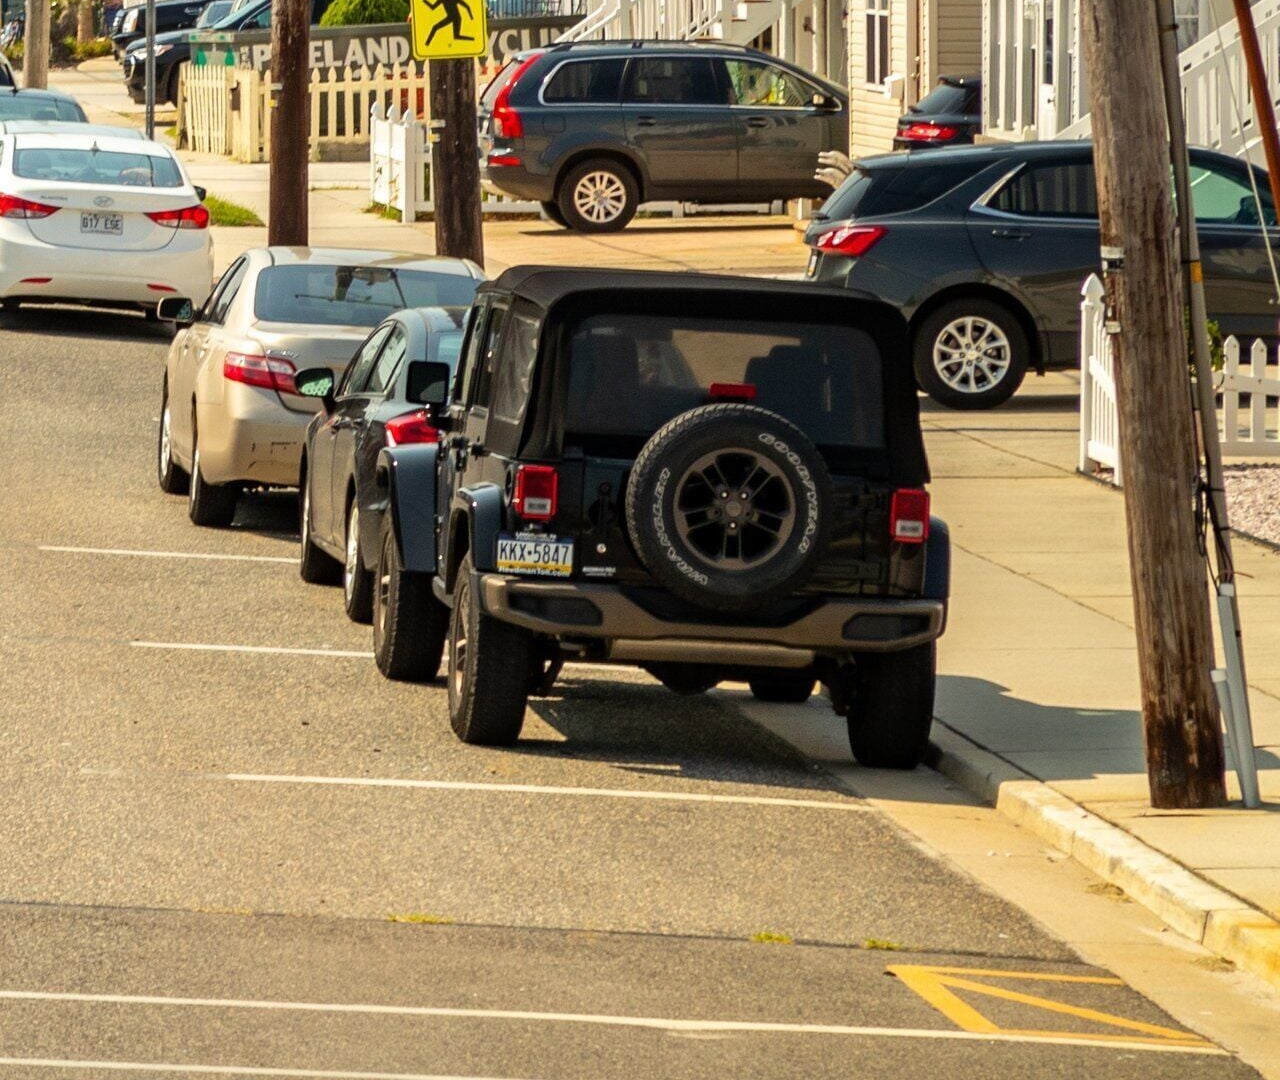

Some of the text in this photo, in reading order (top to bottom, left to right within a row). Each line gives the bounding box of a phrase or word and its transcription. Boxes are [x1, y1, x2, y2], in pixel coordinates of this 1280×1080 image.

[253, 36, 410, 70] PELAND
[653, 467, 709, 586] WRANGLER
[758, 433, 818, 553] GOODYEAR
